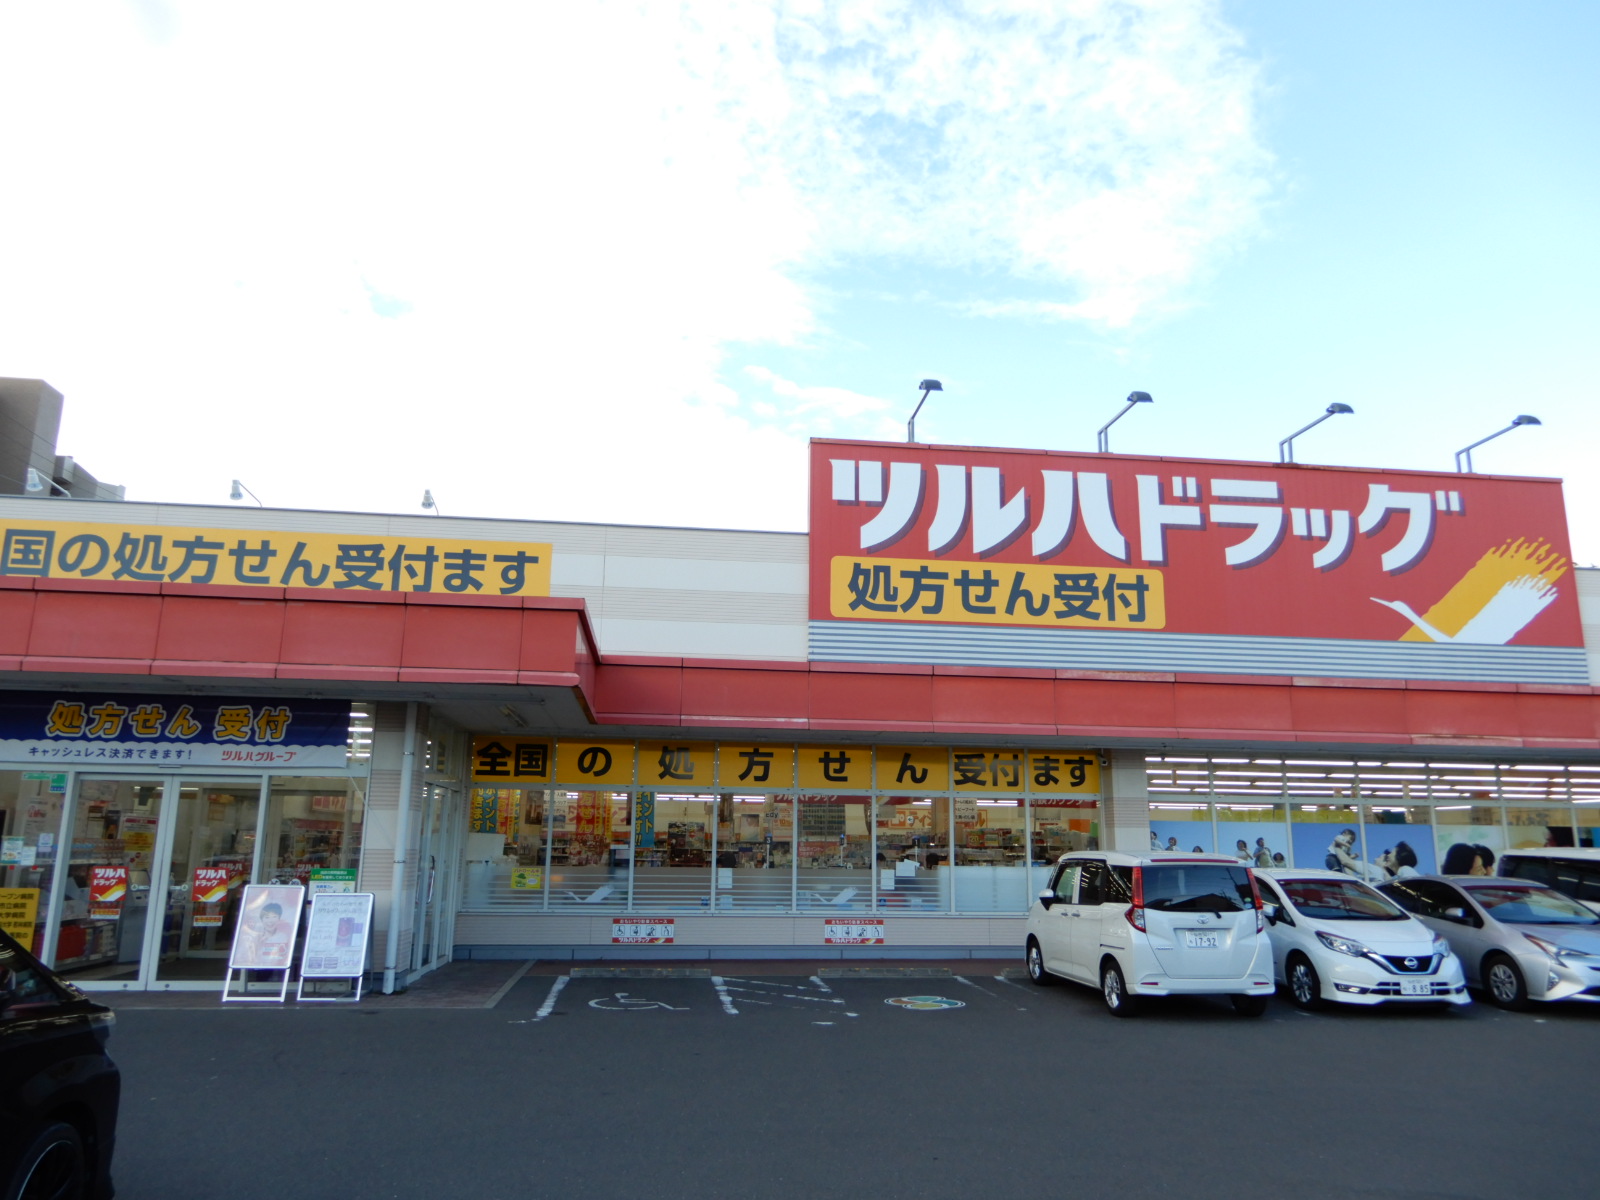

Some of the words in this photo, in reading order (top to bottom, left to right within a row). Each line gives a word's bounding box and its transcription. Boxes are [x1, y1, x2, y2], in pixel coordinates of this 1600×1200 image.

[829, 458, 1462, 572] ツルハドラッグ
[0, 528, 539, 594] 国の処方せん受付ます
[847, 562, 1150, 623] 処方せん受付
[46, 700, 202, 740] 処方せん
[214, 706, 292, 742] 受付
[221, 749, 297, 763] ツルハグループ
[94, 868, 126, 878] ツルハ
[195, 879, 220, 887] ドラッグ
[196, 869, 227, 879] ツルハ
